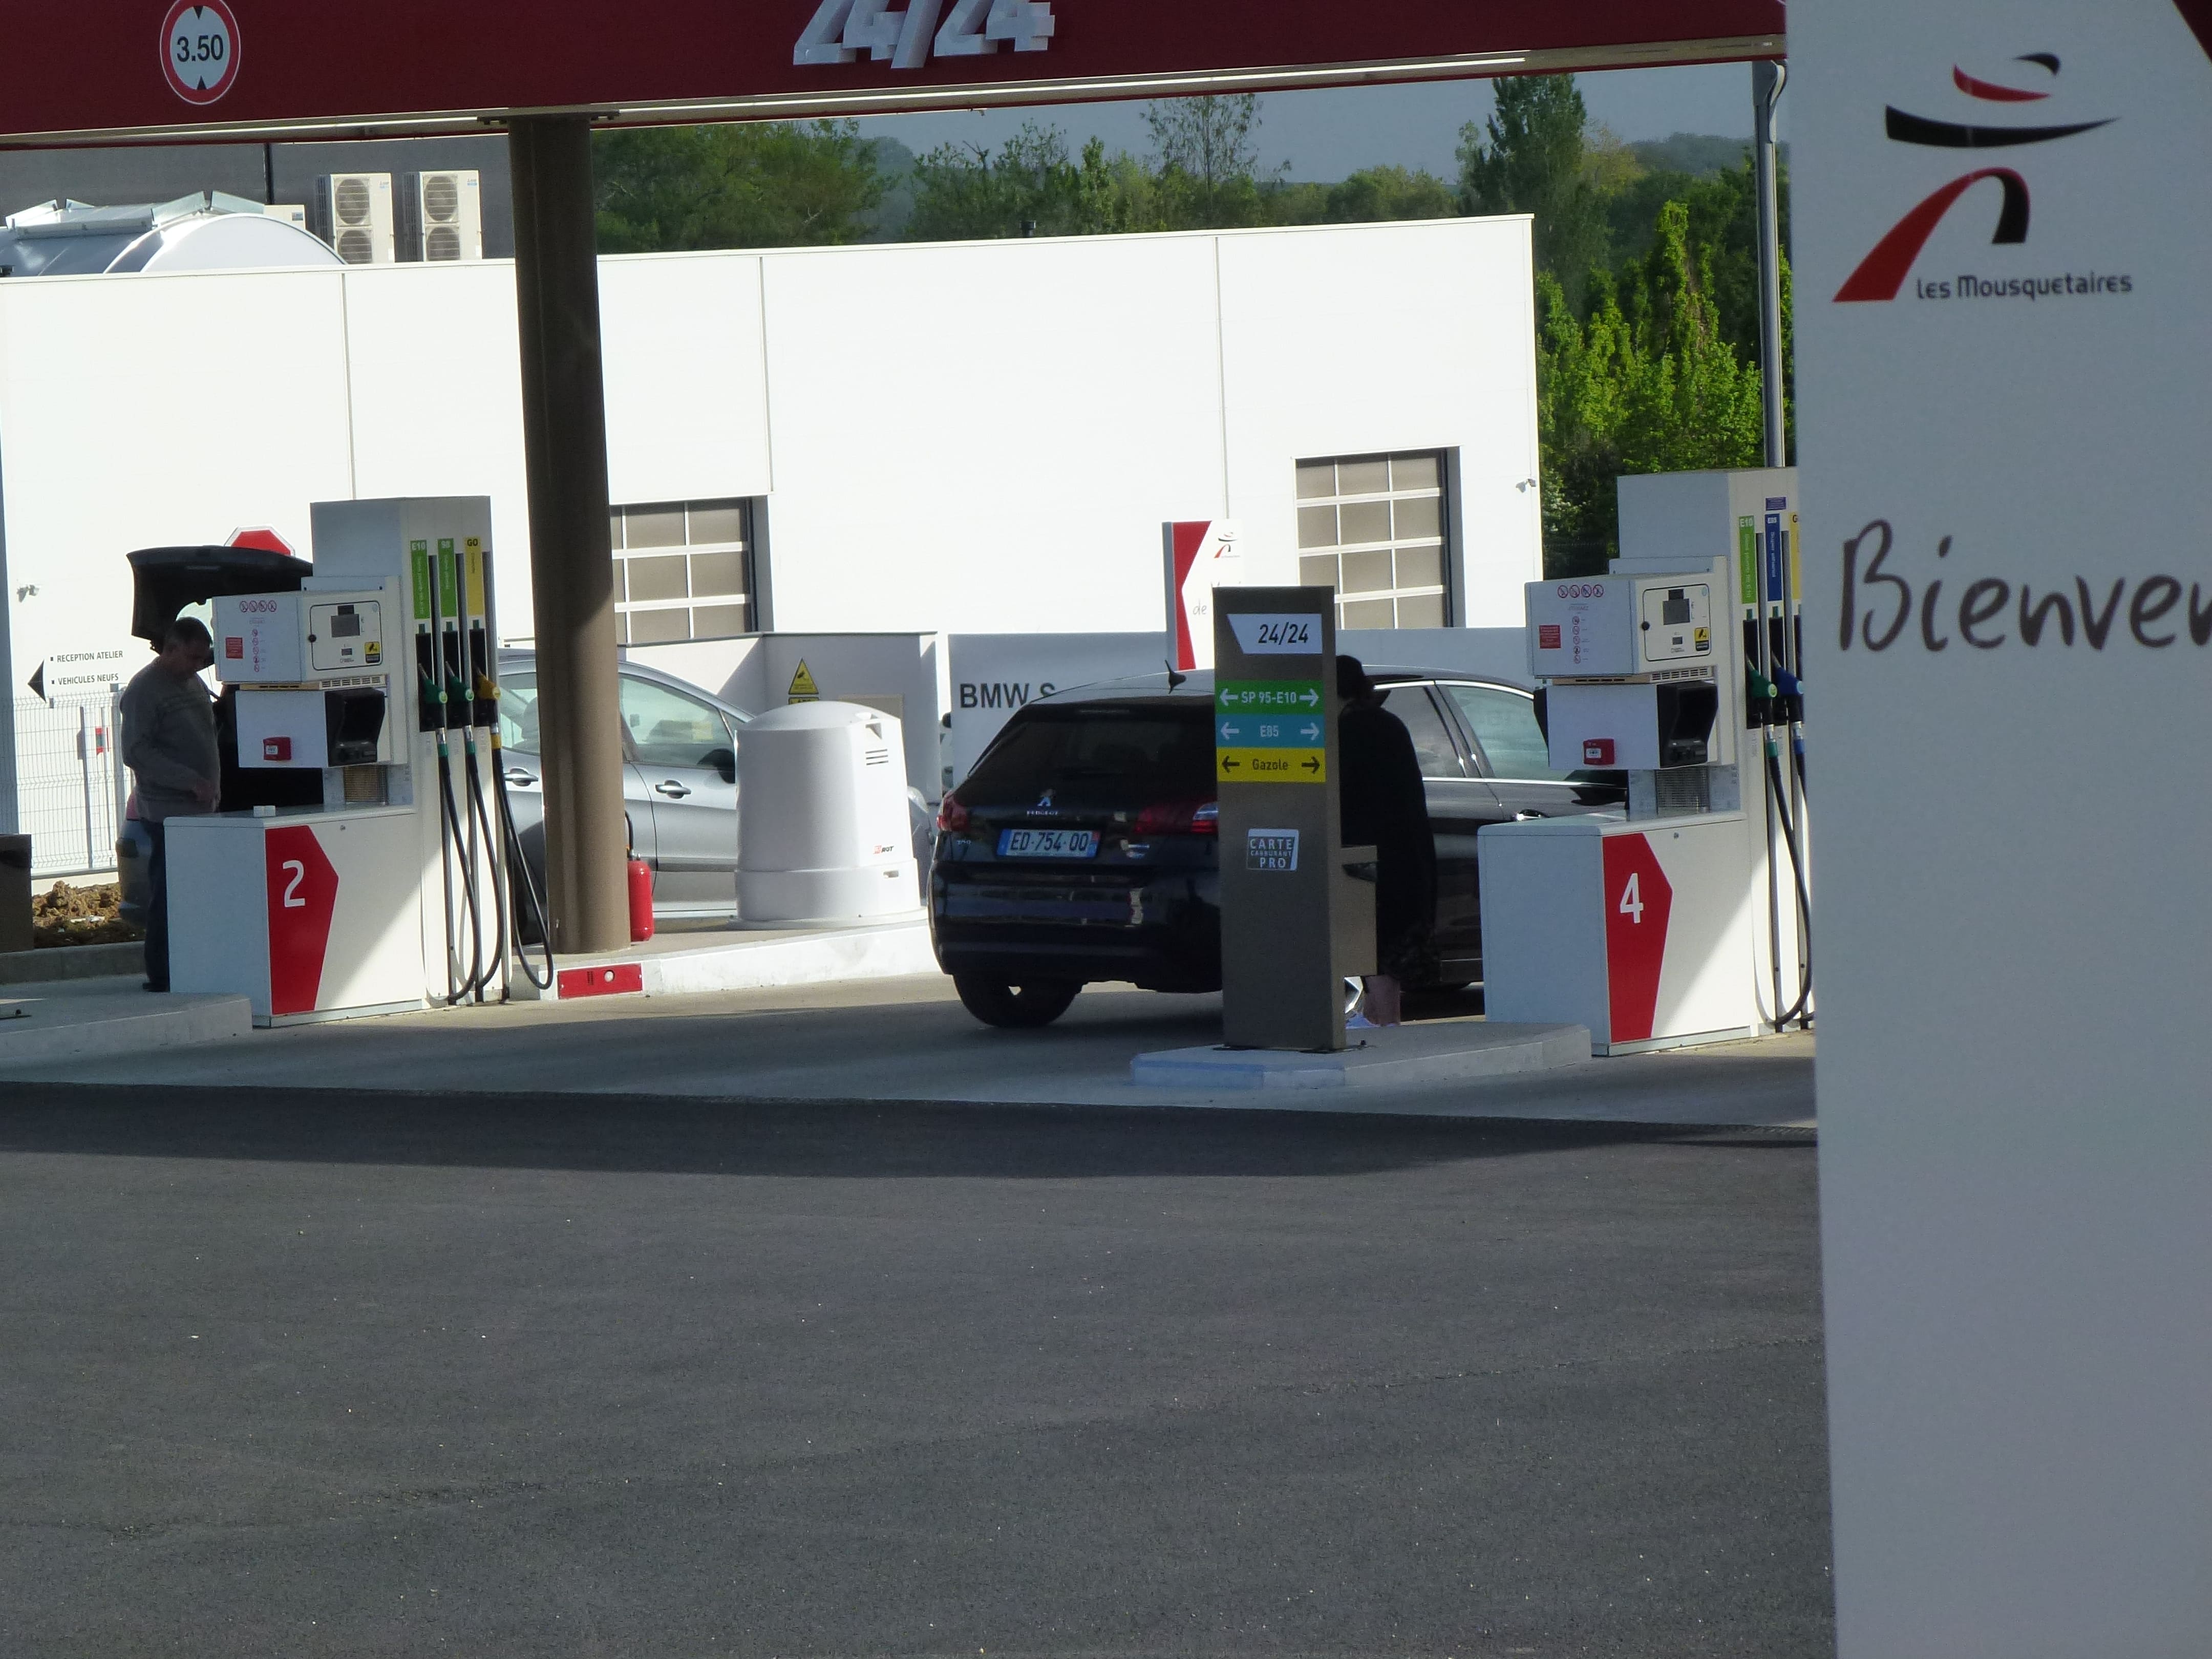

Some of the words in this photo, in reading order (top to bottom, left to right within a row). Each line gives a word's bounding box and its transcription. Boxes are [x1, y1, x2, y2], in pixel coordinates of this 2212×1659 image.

[177, 34, 224, 62] 3.50
[1917, 277, 1950, 299] les
[1958, 270, 2133, 301] Mousquetaires
[467, 539, 478, 547] GO
[1258, 622, 1309, 645] 24/24
[57, 652, 94, 663] RECEPTION
[96, 650, 123, 659] ATELIER
[58, 675, 95, 685] VEHICULES
[97, 673, 119, 682] NEUFS
[960, 683, 1030, 708] BMW
[1241, 692, 1256, 704] SP
[1259, 692, 1296, 704] 95-E10
[1252, 758, 1289, 771] Gazole
[1249, 839, 1293, 849] CARTE
[1260, 858, 1286, 868] PRO
[282, 860, 305, 908] 2
[1620, 873, 1644, 924] 4
